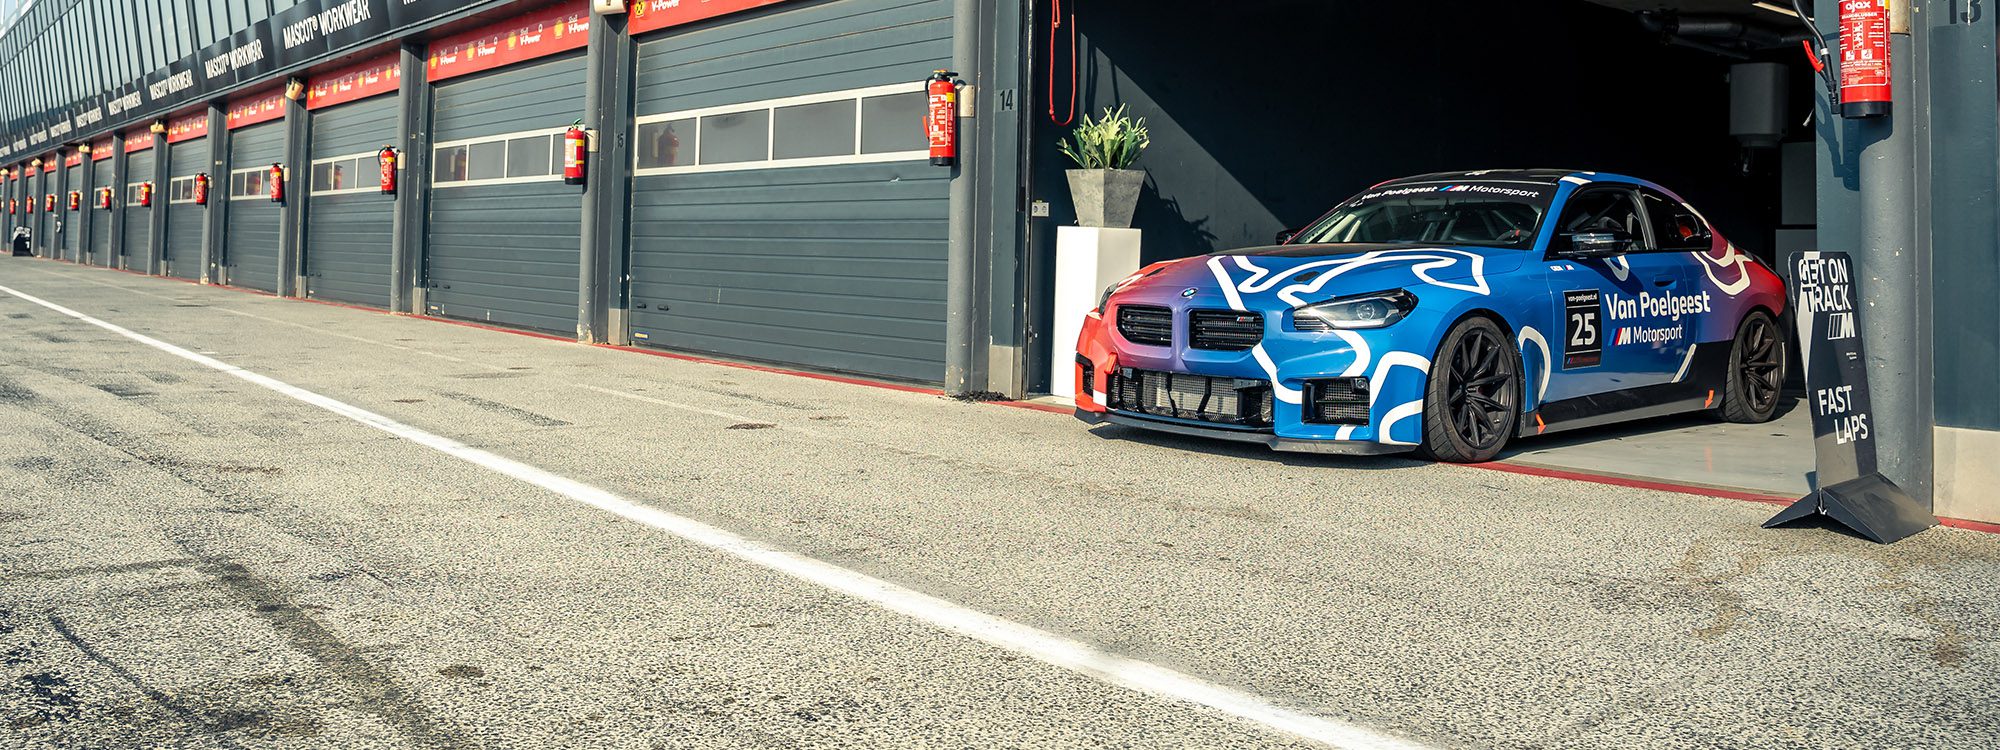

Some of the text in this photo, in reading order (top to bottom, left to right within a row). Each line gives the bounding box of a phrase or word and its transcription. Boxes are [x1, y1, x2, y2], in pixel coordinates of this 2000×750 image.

[318, 0, 371, 36] WORKWEAR
[1845, 0, 1872, 12] ajax
[568, 22, 589, 34] V-Powe
[229, 38, 264, 70] WORKWEAR
[1000, 88, 1014, 111] 14
[1468, 185, 1540, 198] Motorsport
[1798, 258, 1849, 285] GET ON
[1605, 290, 1711, 322] Van Poelgeest
[1802, 284, 1852, 312] TRACK
[1571, 313, 1597, 347] 25
[1633, 324, 1683, 346] Motorsport
[1818, 385, 1852, 416] FAST
[1834, 413, 1868, 445] LAPS
